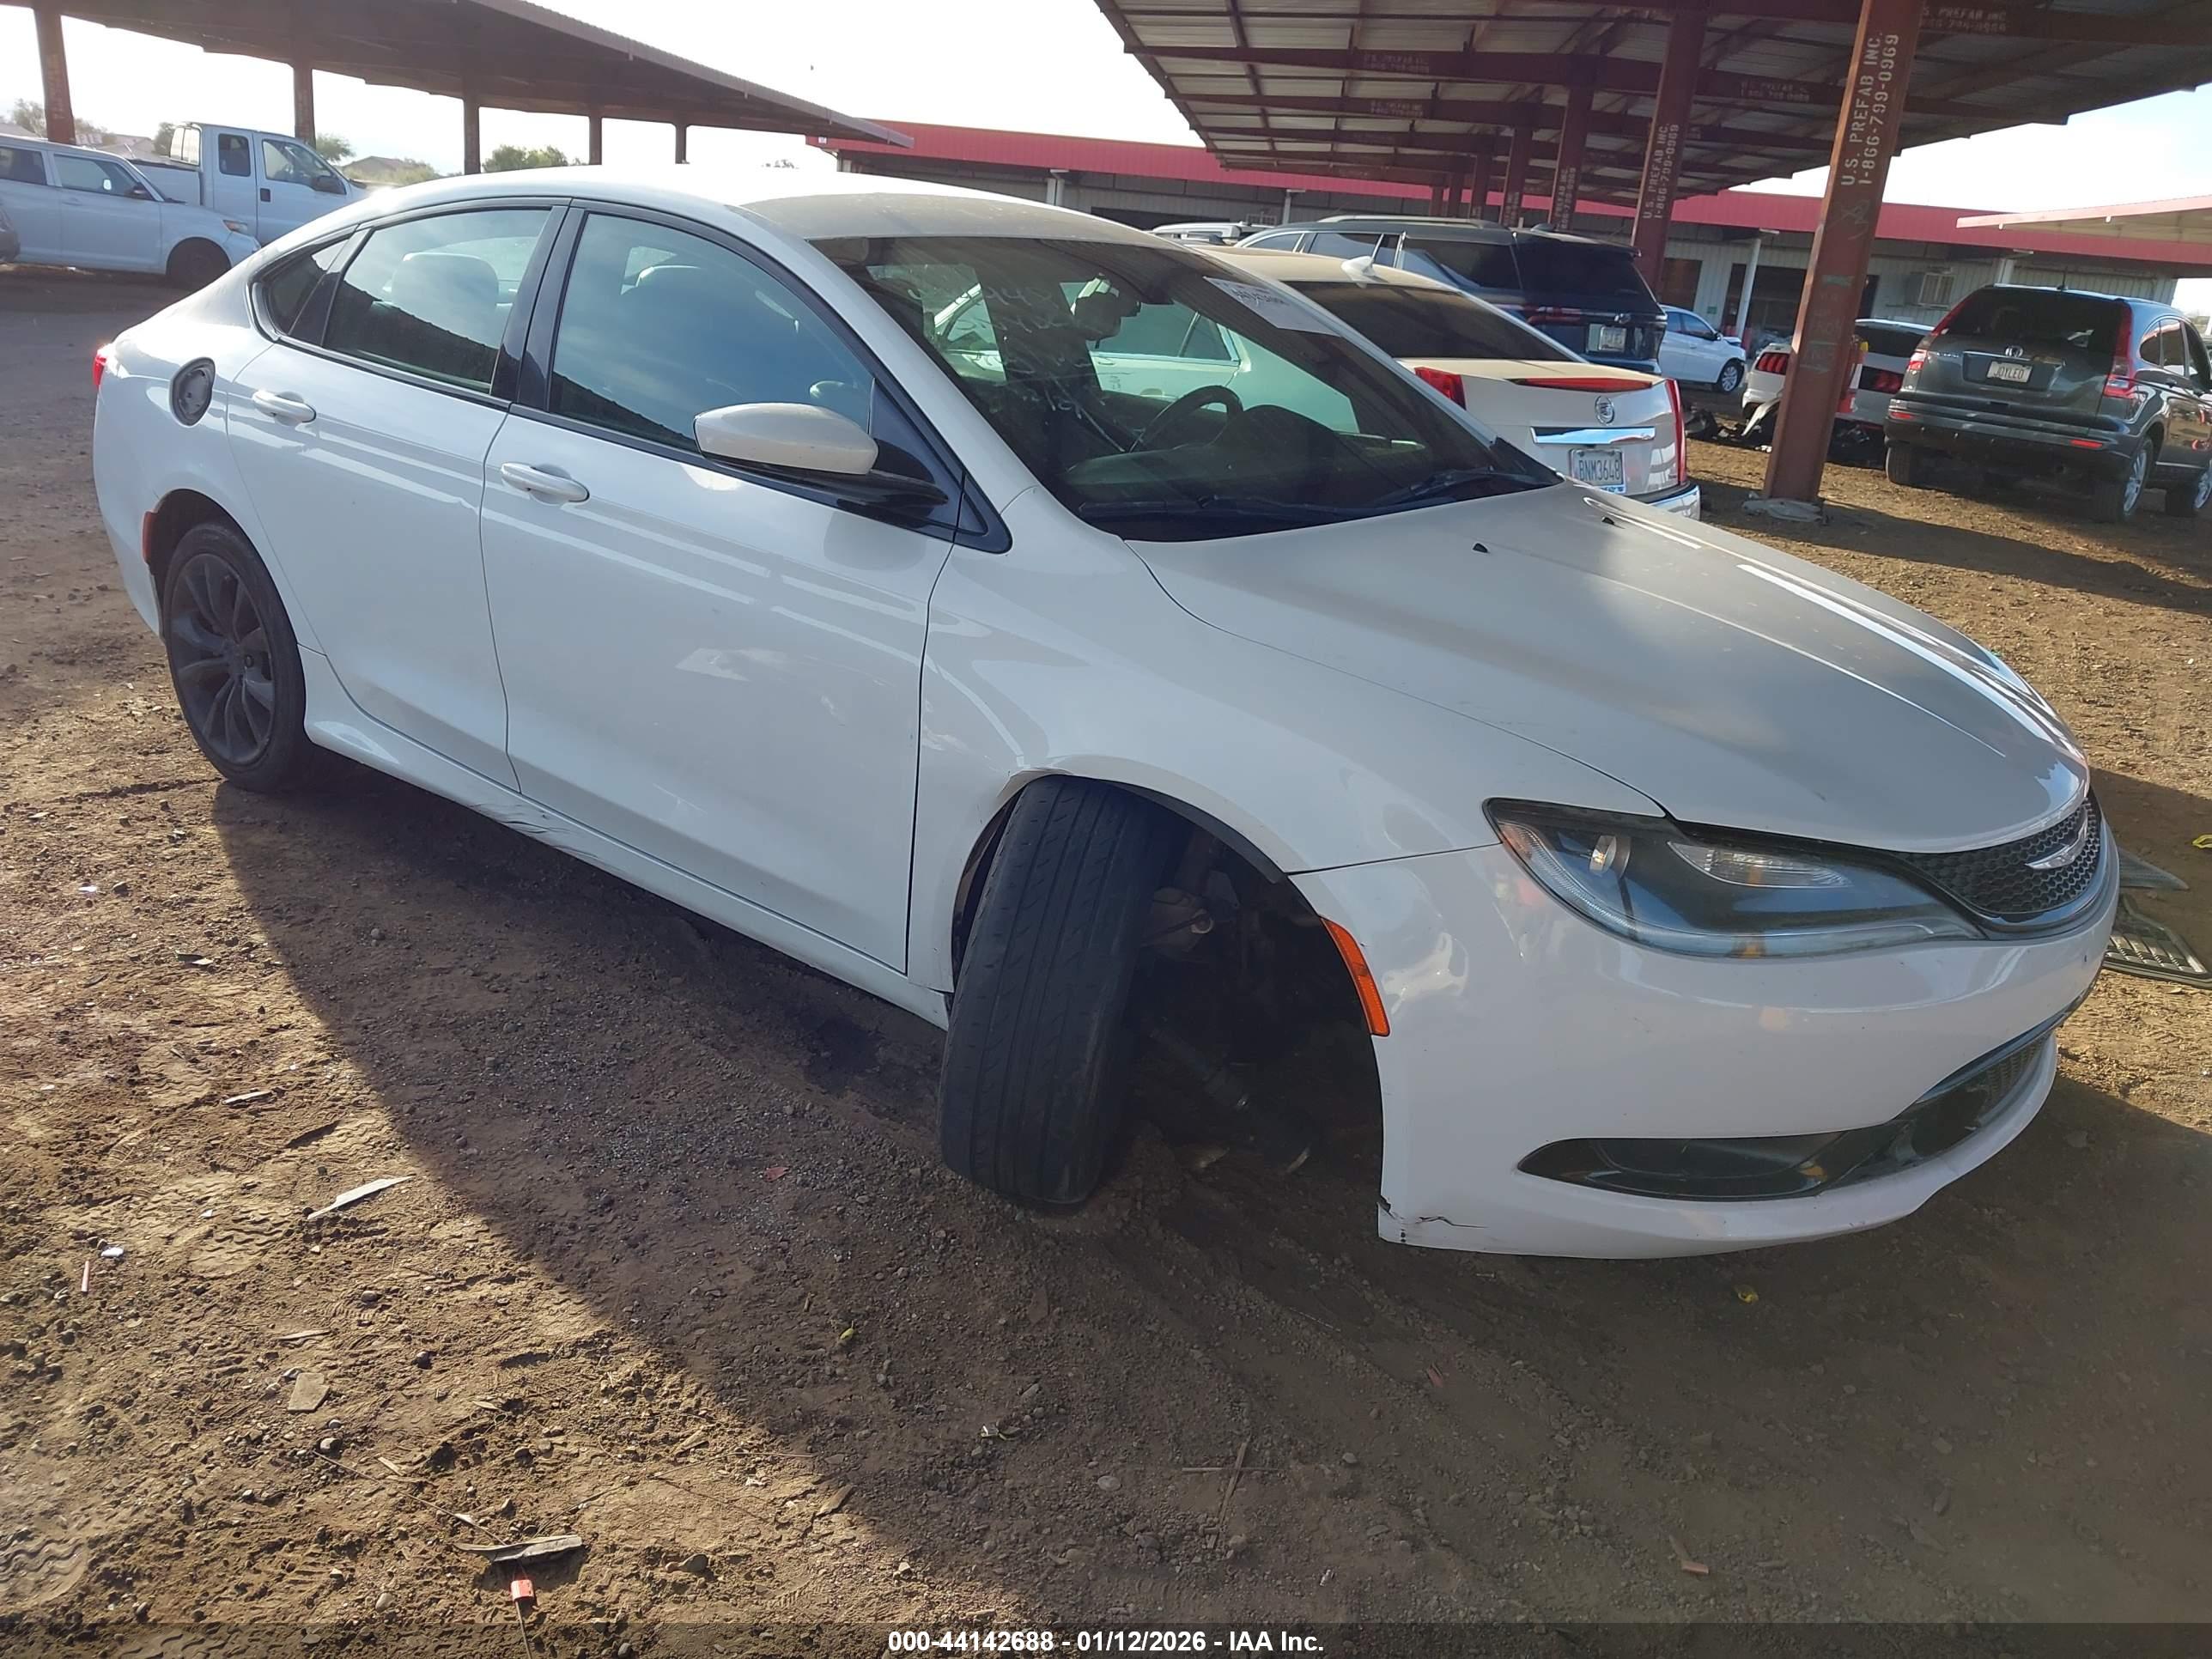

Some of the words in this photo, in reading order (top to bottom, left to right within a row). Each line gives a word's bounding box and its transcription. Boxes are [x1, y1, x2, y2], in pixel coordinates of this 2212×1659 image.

[1841, 153, 1859, 185] U.S.
[1850, 75, 1874, 143] PREFAB
[1863, 32, 1883, 65] INC.
[1859, 34, 1900, 185] 1-866-799-0969
[1649, 150, 1664, 192] PREFAB
[1578, 459, 1620, 481] BNM3648
